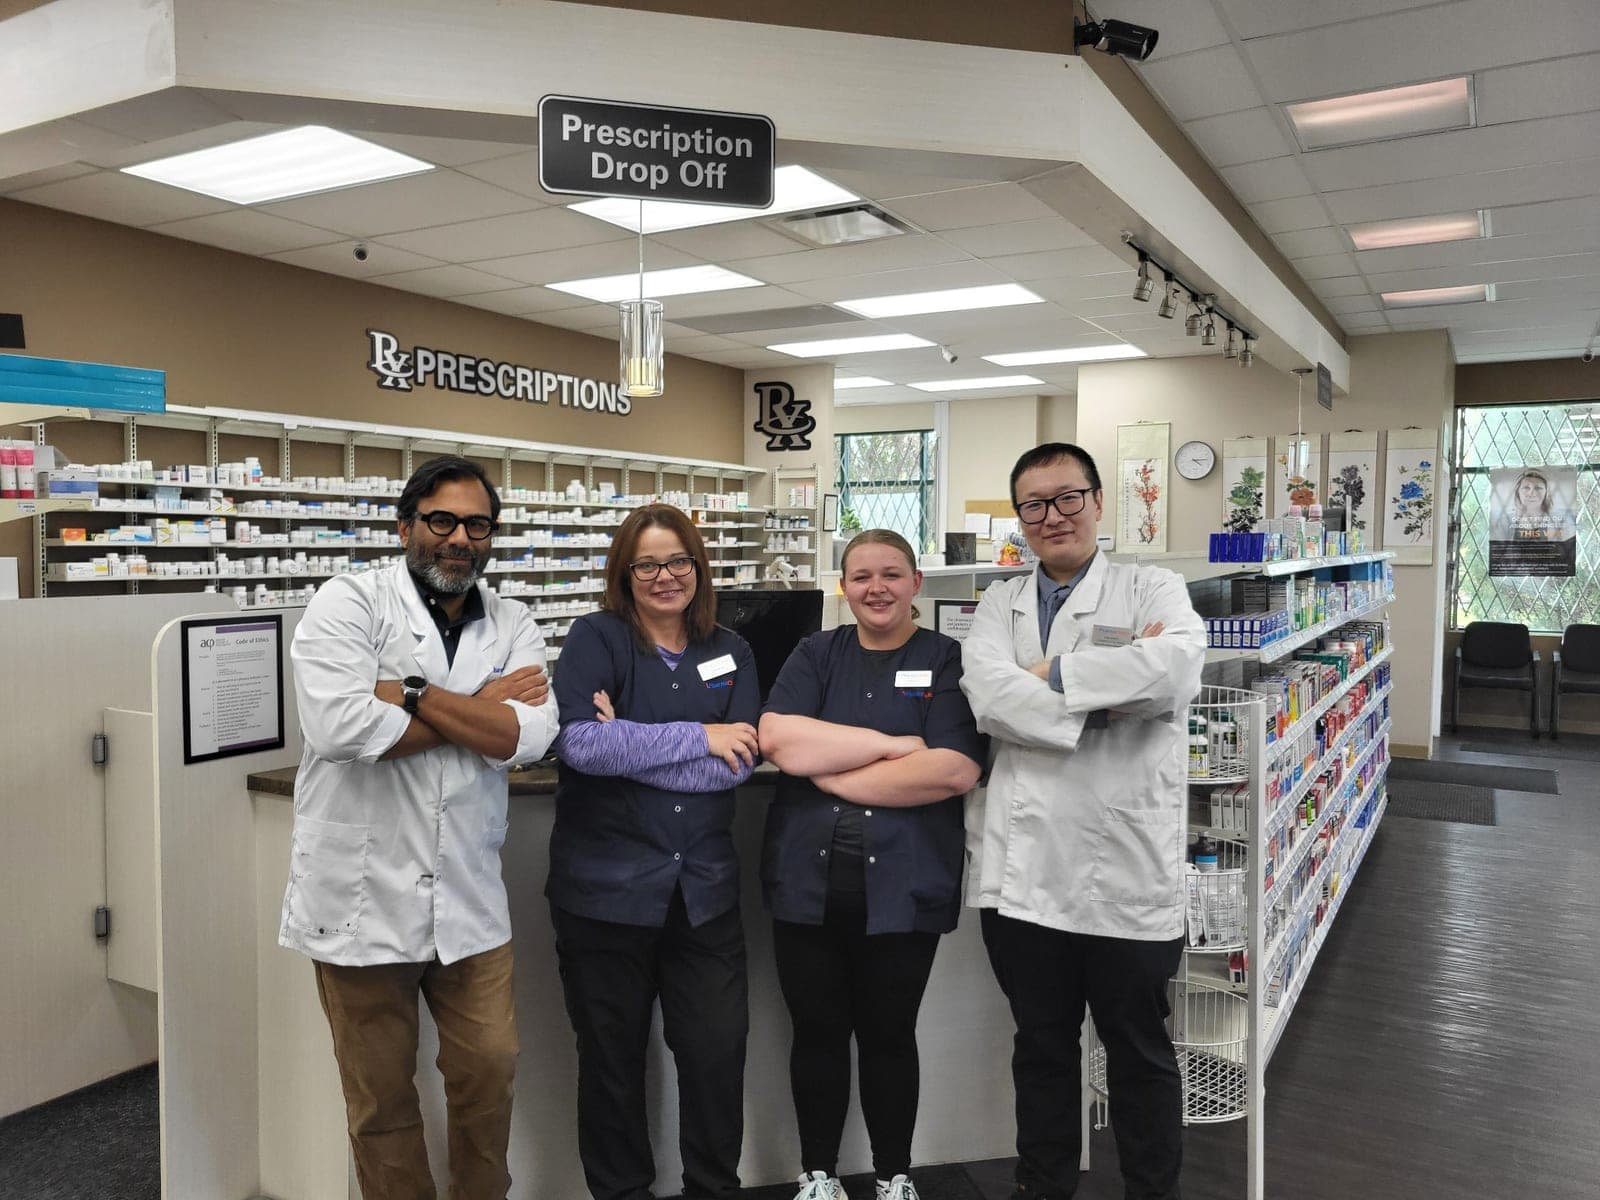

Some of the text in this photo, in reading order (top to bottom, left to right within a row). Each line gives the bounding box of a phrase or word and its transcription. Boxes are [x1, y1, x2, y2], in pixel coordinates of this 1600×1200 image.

[561, 113, 753, 158] Prescription
[591, 152, 728, 190] Drop Off
[415, 347, 633, 417] PRESCRIPTIONS
